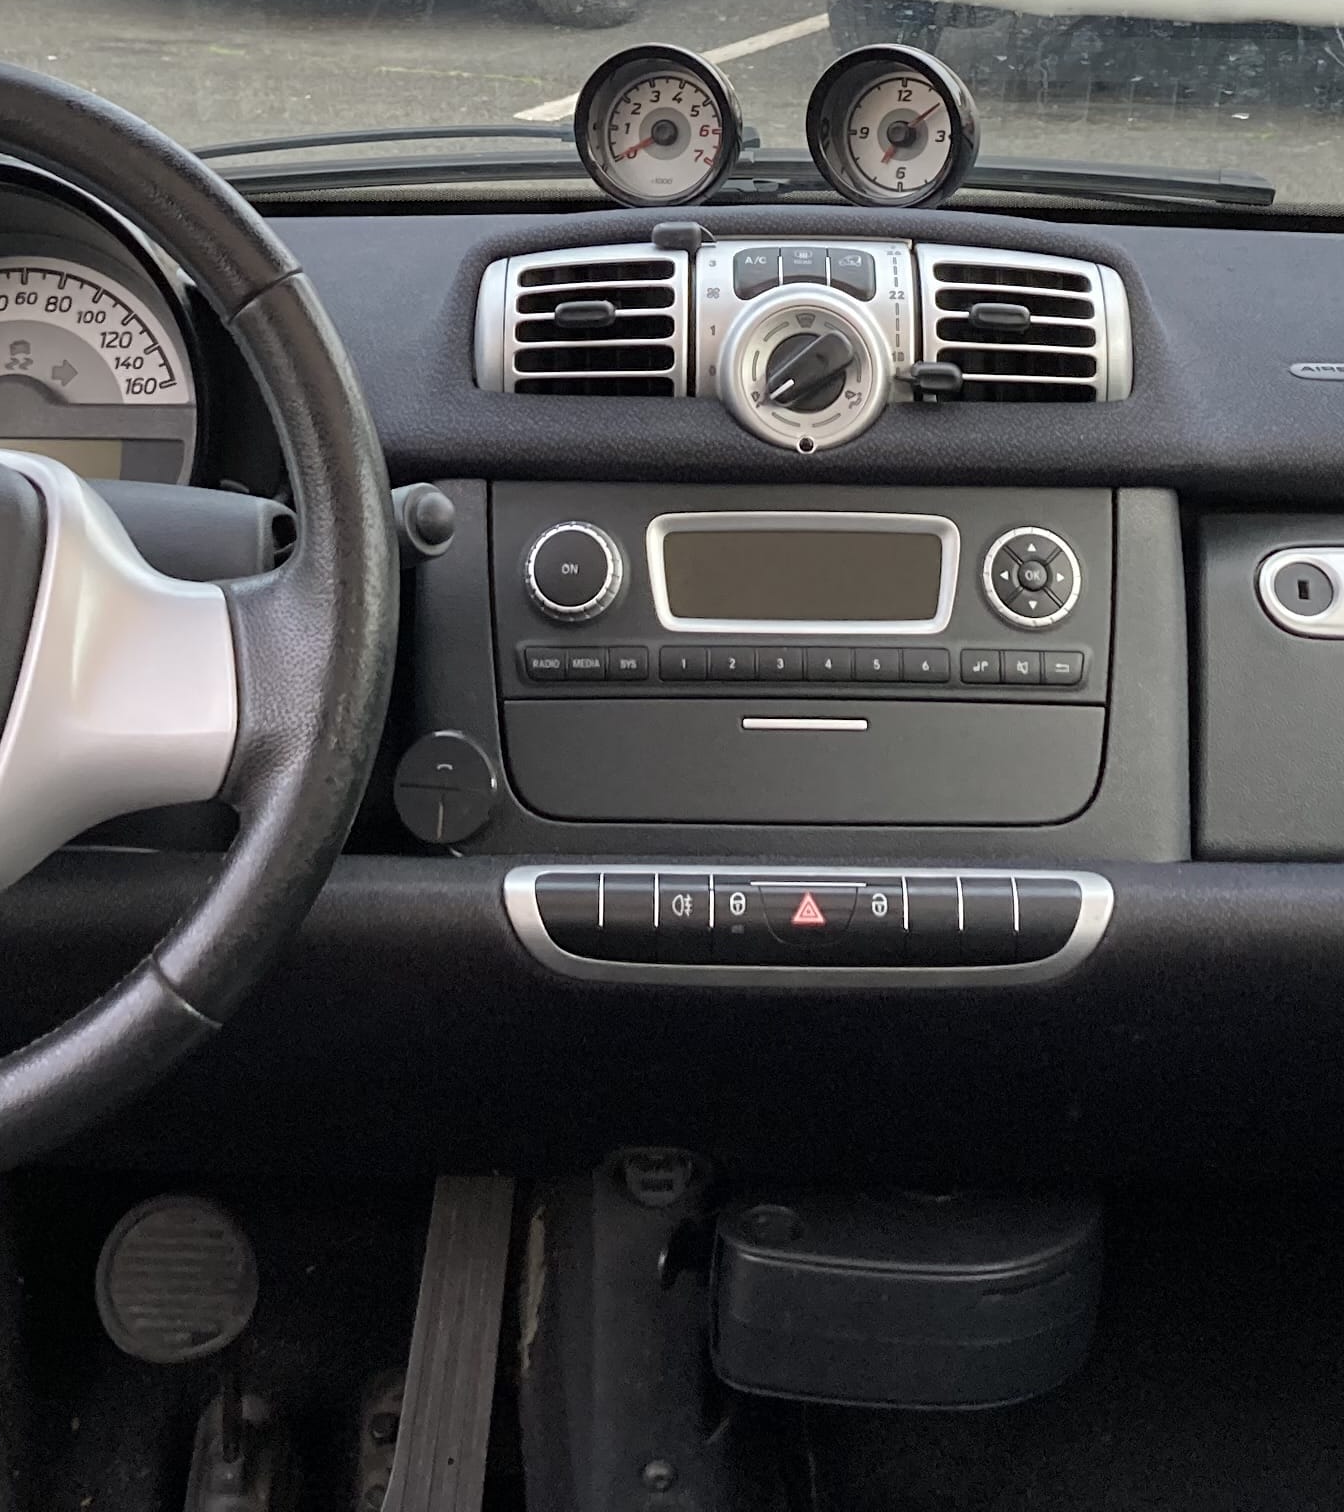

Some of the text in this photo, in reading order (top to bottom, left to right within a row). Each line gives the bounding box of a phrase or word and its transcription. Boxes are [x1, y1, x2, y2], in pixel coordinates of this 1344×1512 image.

[649, 90, 661, 103] 3
[671, 91, 683, 104] 4
[897, 89, 913, 103] 12
[630, 102, 642, 116] 2
[689, 104, 701, 118] 5
[624, 122, 631, 135] 1
[699, 124, 710, 138] 6
[858, 126, 870, 140] 9
[934, 130, 946, 143] 3
[693, 149, 704, 163] 7
[895, 166, 907, 180] 6
[708, 259, 717, 268] 3
[744, 255, 768, 265] A/C
[15, 291, 38, 306] 60
[888, 290, 905, 300] 22
[44, 295, 73, 313] 80
[76, 310, 107, 324] 100
[99, 330, 133, 349] 120
[114, 356, 144, 370] 140
[125, 377, 157, 395] 160
[561, 563, 579, 575] ON
[1024, 569, 1041, 581] OK
[532, 658, 561, 669] RADIO
[572, 658, 601, 669] MEDIA
[619, 658, 638, 670] SYS
[681, 658, 687, 669] 1
[729, 658, 736, 670] 2
[776, 657, 785, 670] 3
[824, 657, 833, 670] 4
[873, 658, 881, 671] 5
[921, 659, 930, 671] 6
